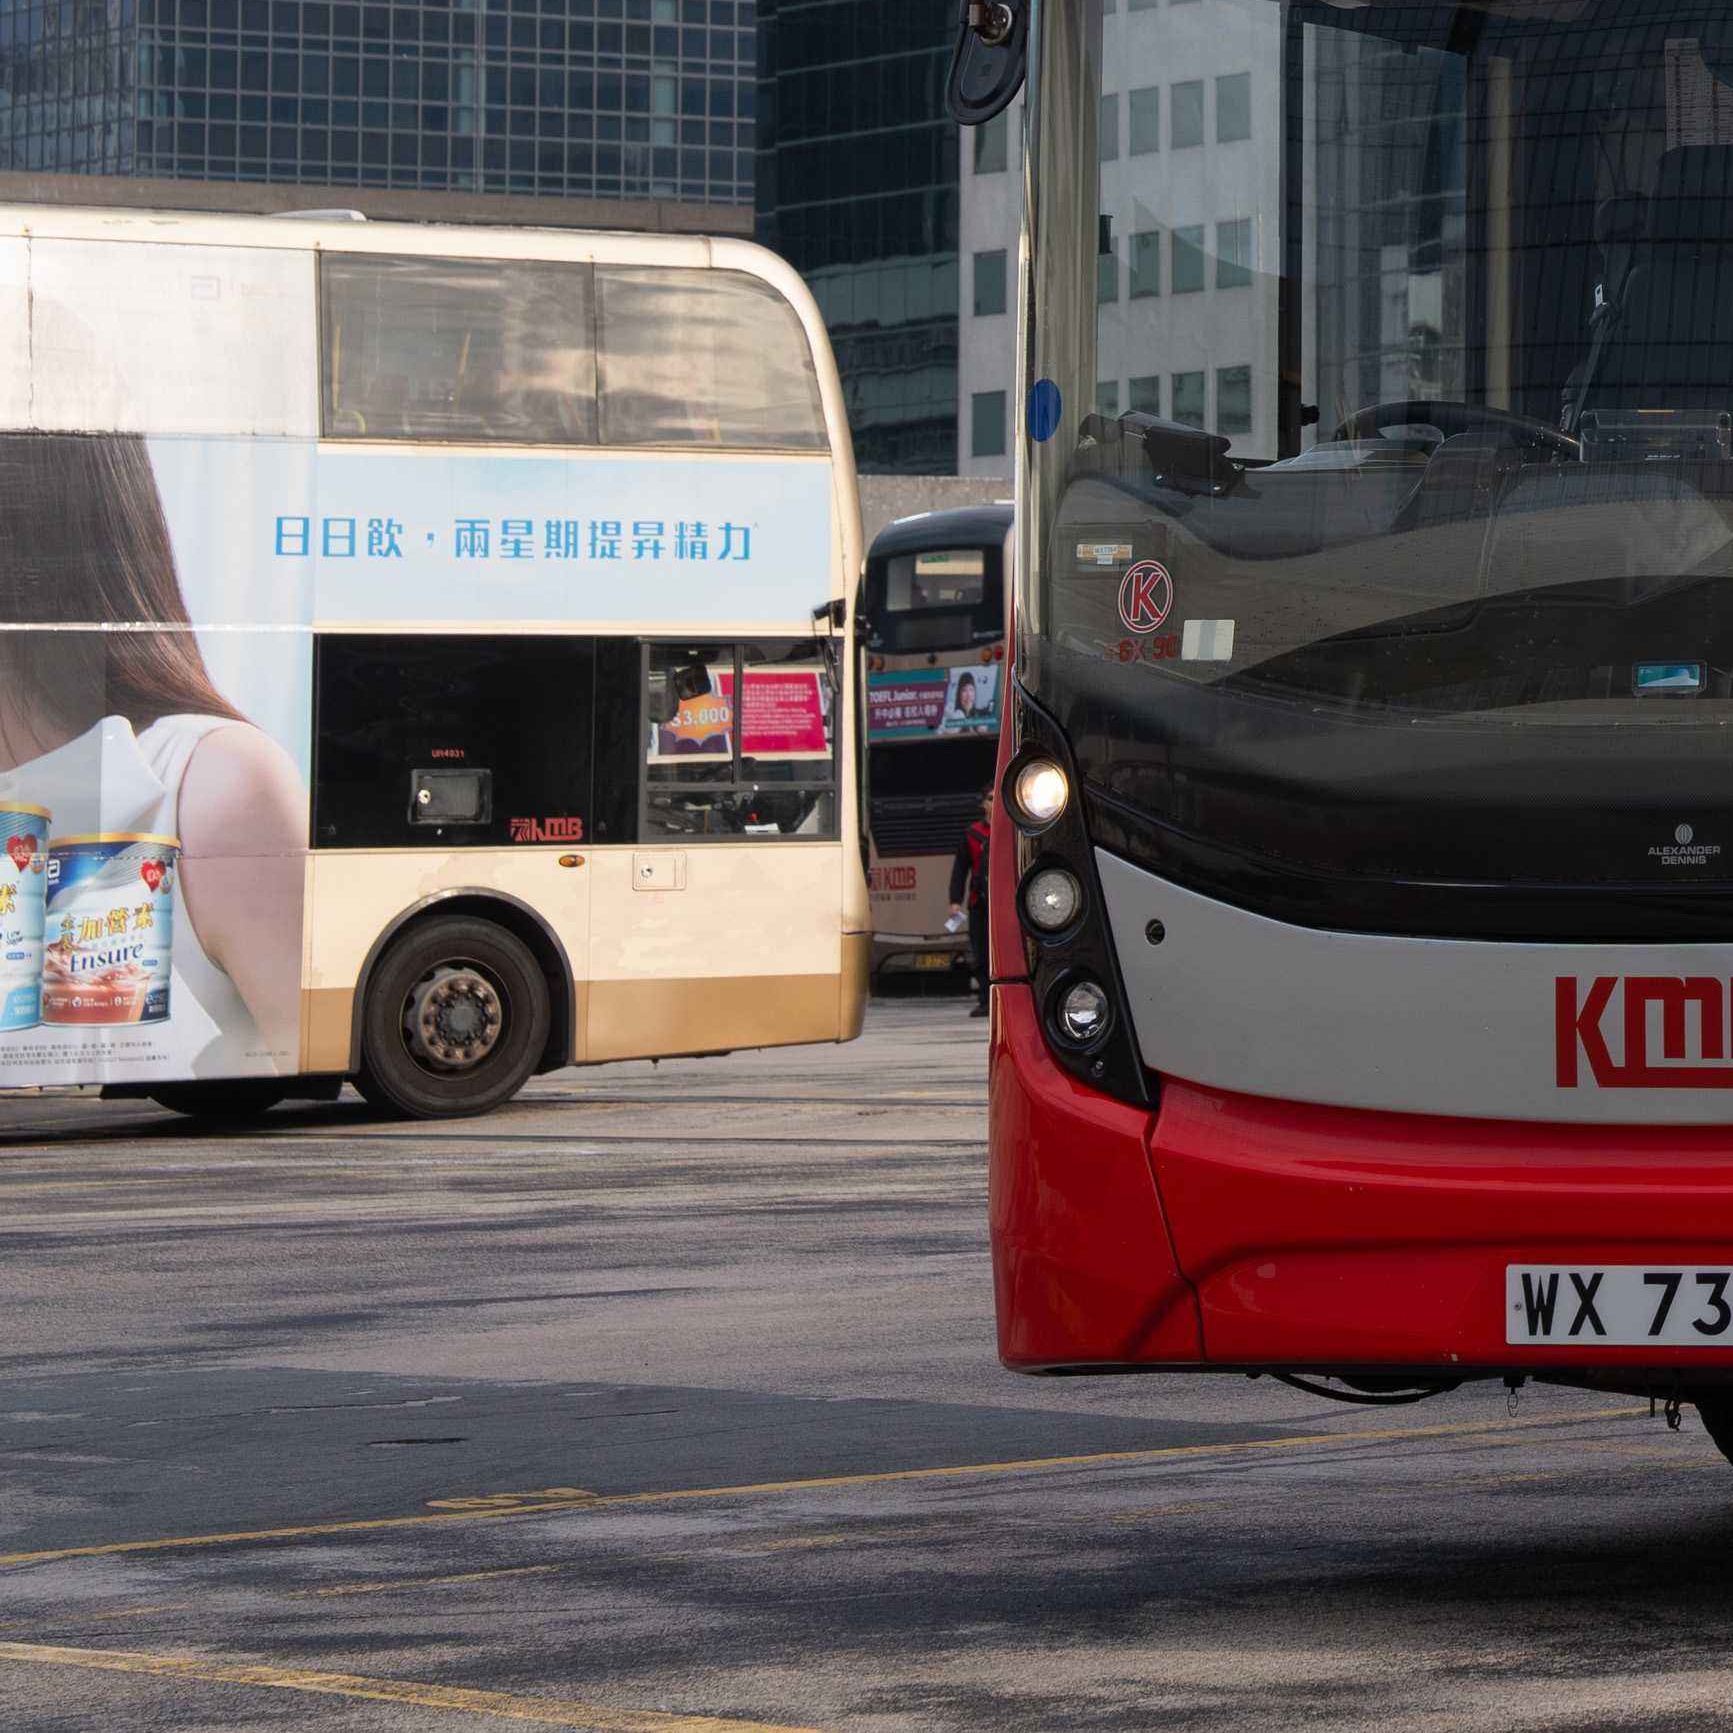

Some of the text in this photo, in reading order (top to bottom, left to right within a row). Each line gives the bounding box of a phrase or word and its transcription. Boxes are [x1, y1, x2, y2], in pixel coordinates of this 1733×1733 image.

[1130, 571, 1163, 622] K
[1647, 845, 1721, 856] ALEXANDER
[1661, 855, 1707, 866] DENNIS
[70, 942, 144, 973] Ensure
[1520, 1272, 1608, 1337] WX
